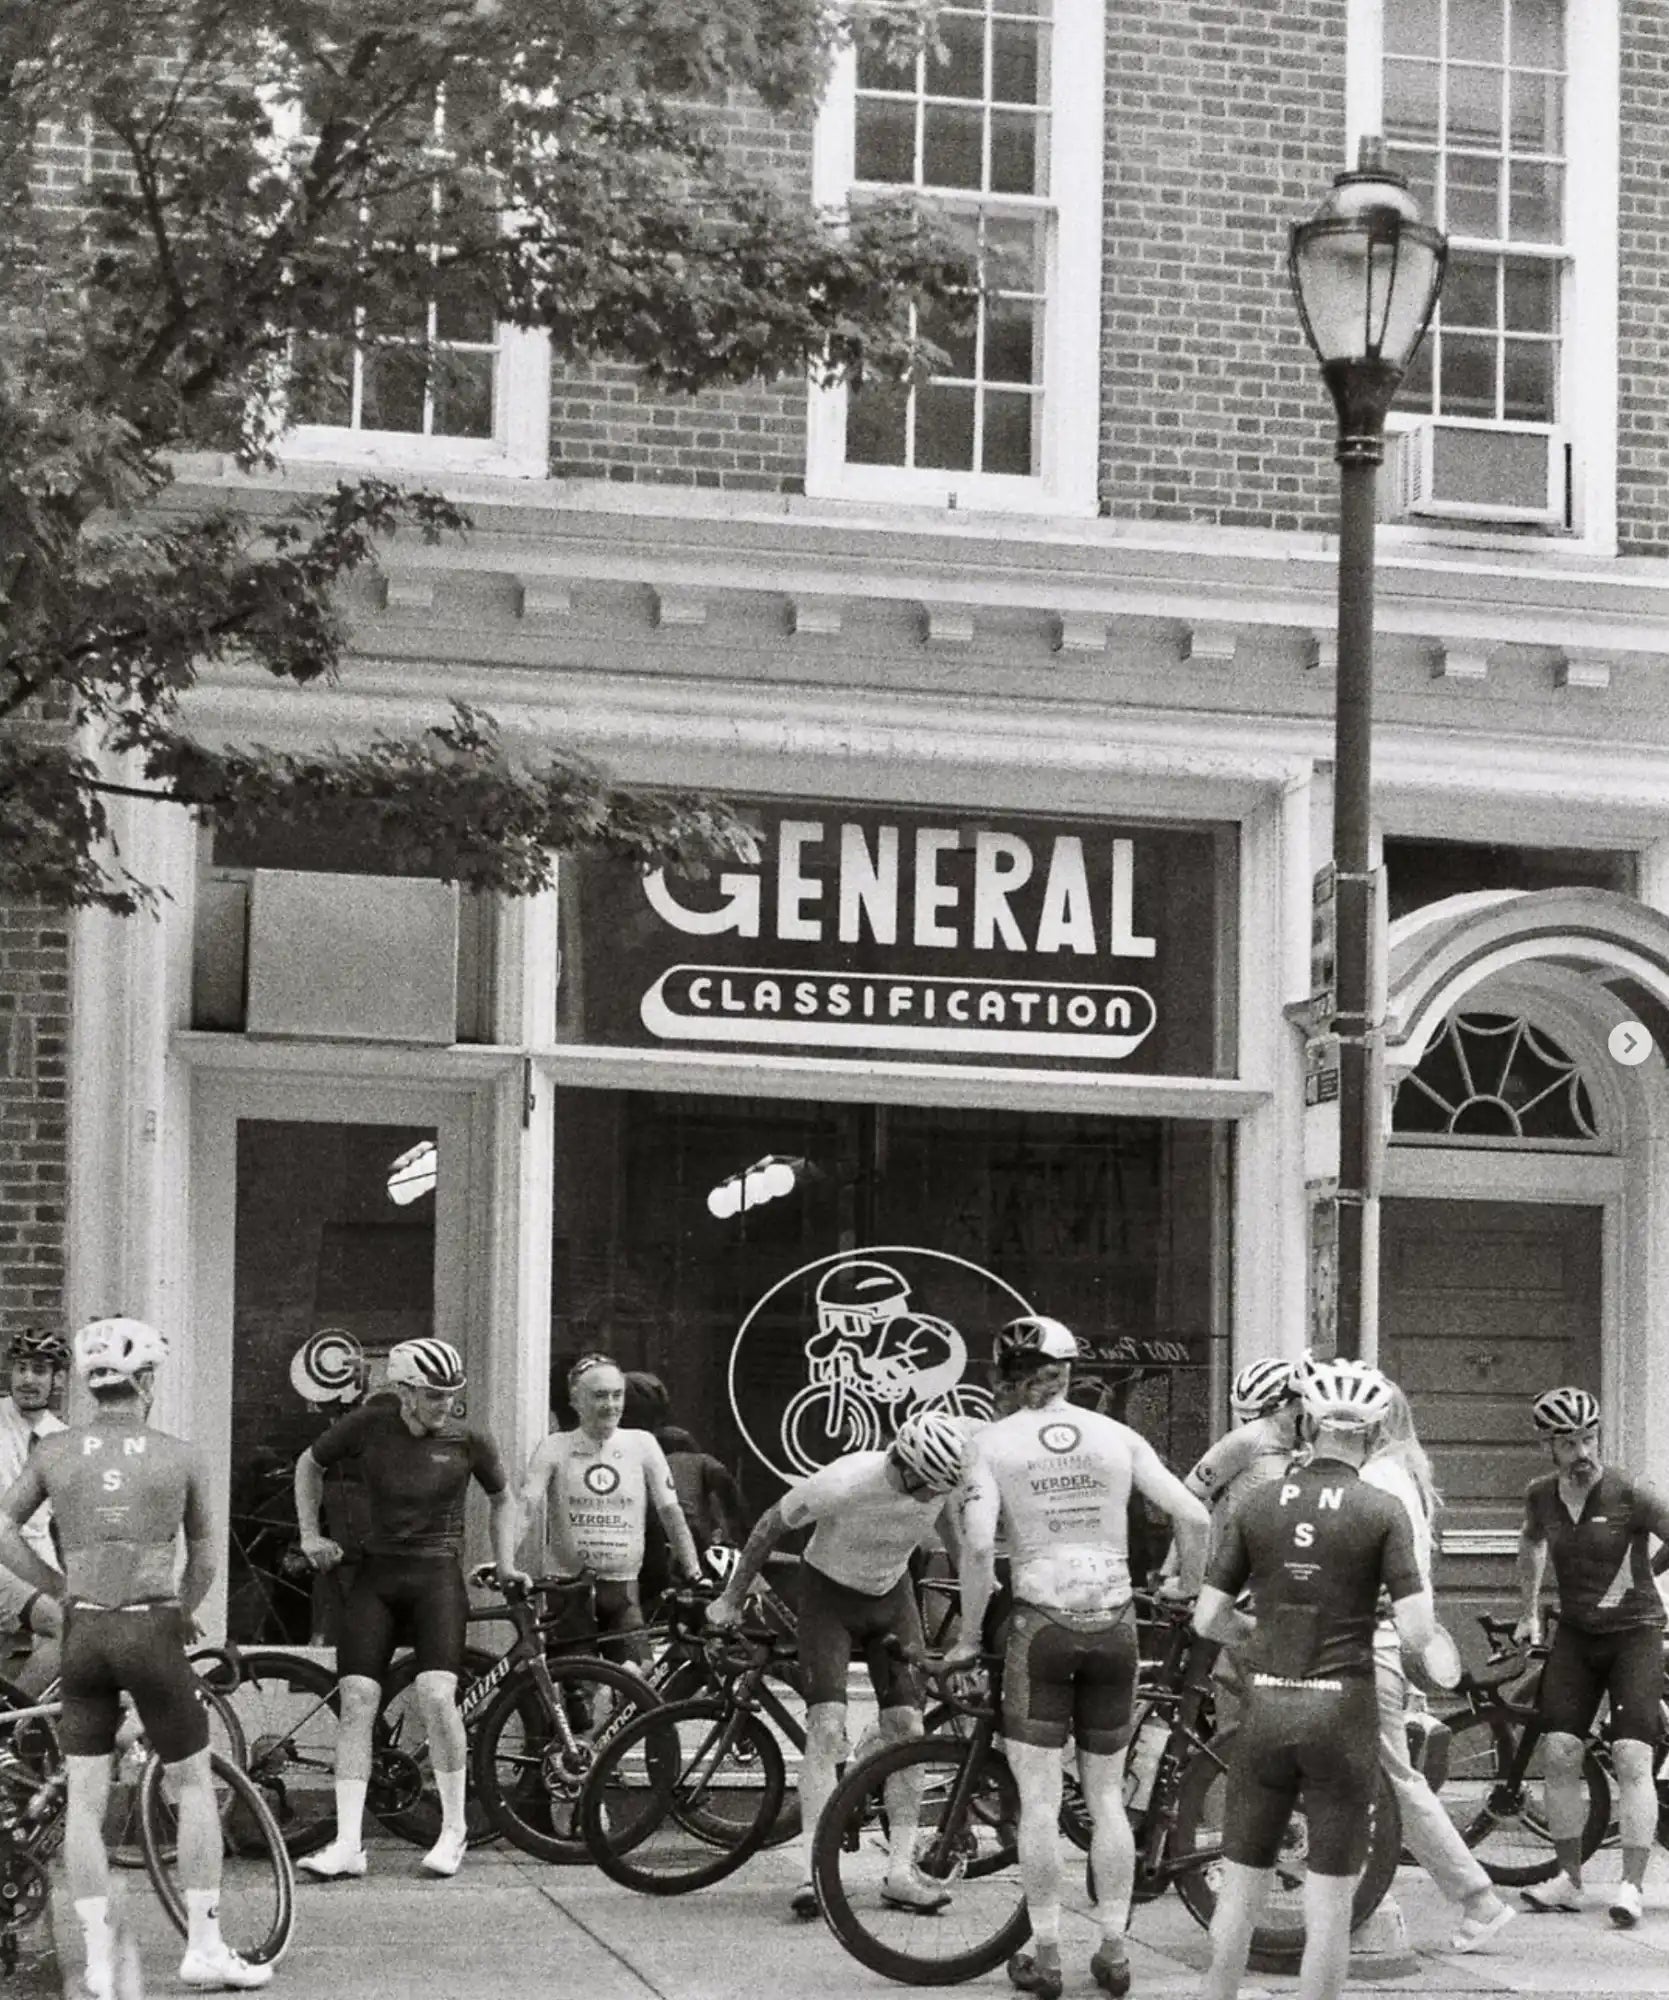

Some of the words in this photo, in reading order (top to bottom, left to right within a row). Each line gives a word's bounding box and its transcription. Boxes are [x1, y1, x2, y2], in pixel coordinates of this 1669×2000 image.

[642, 819, 1156, 958] GENERAL
[688, 977, 1132, 1030] CLASSIFICATION
[82, 1436, 102, 1455] P
[123, 1436, 146, 1456] N
[103, 1469, 121, 1492] S
[1279, 1484, 1300, 1506] P
[1318, 1487, 1344, 1510] N
[1294, 1522, 1315, 1547] S
